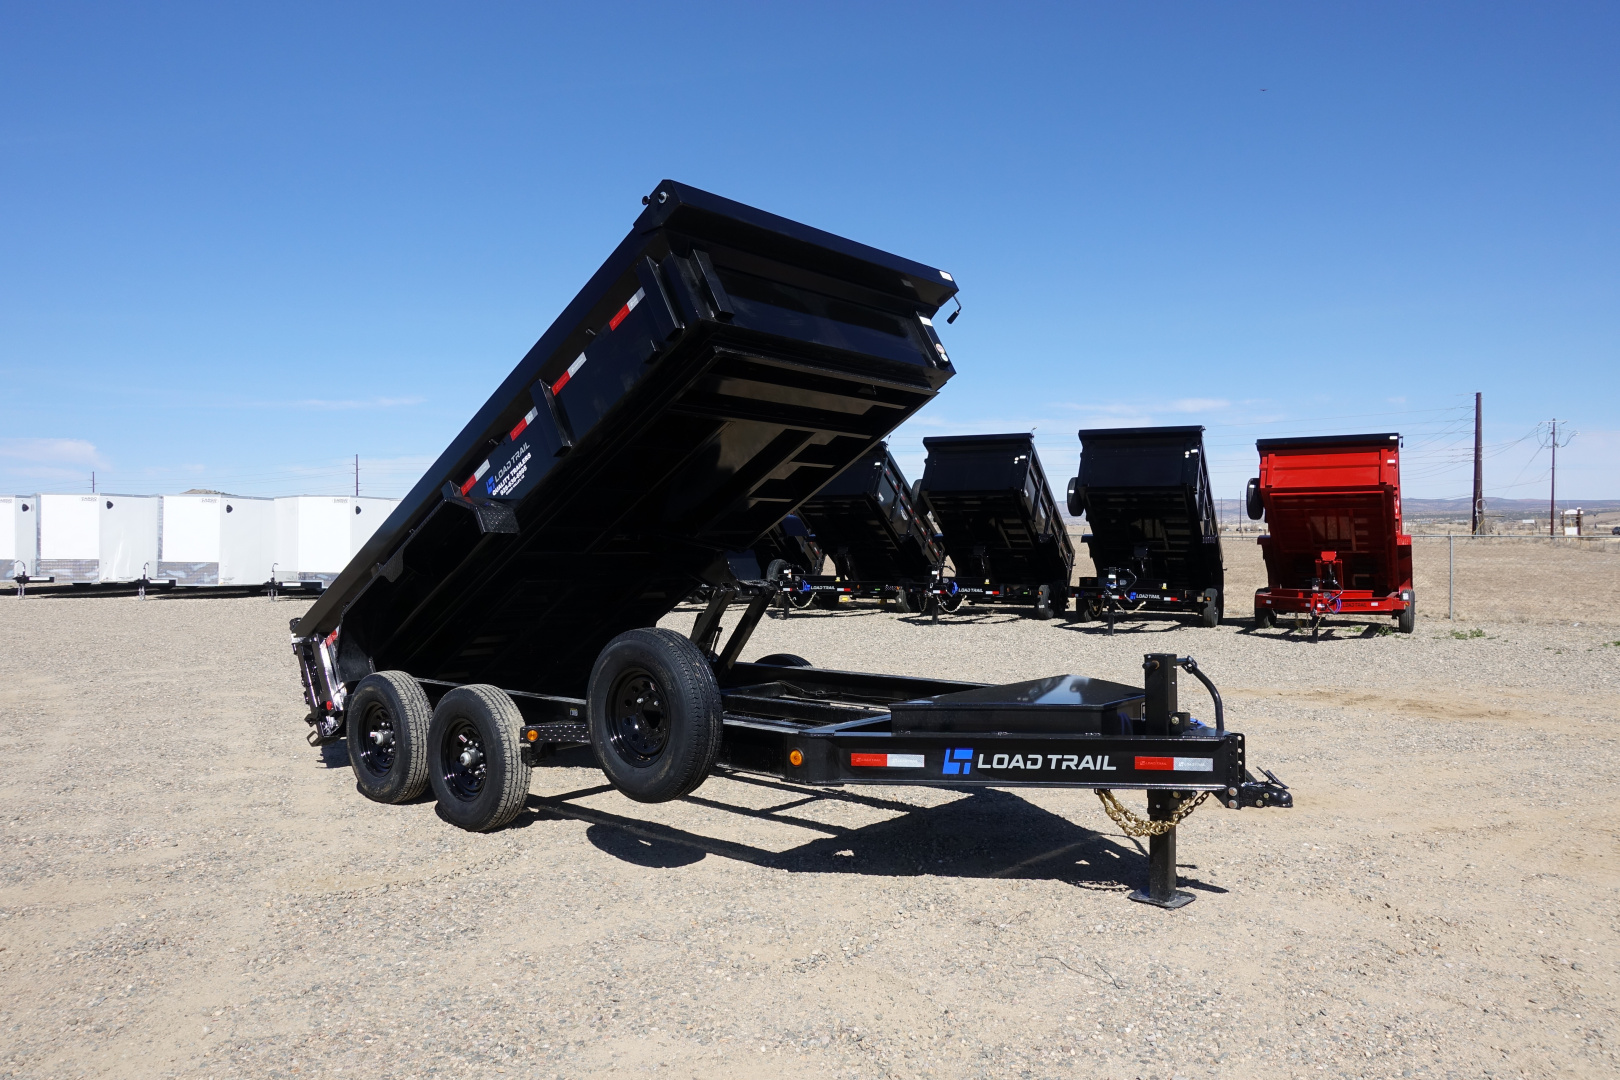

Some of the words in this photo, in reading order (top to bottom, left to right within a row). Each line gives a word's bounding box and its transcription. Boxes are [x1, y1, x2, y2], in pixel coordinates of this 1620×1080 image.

[492, 474, 510, 496] QUALITY
[510, 452, 532, 477] TRAILERS
[494, 460, 512, 483] LOAD
[510, 442, 531, 464] TRAIL
[977, 753, 1043, 770] LOAD
[1047, 755, 1117, 771] TRAIL
